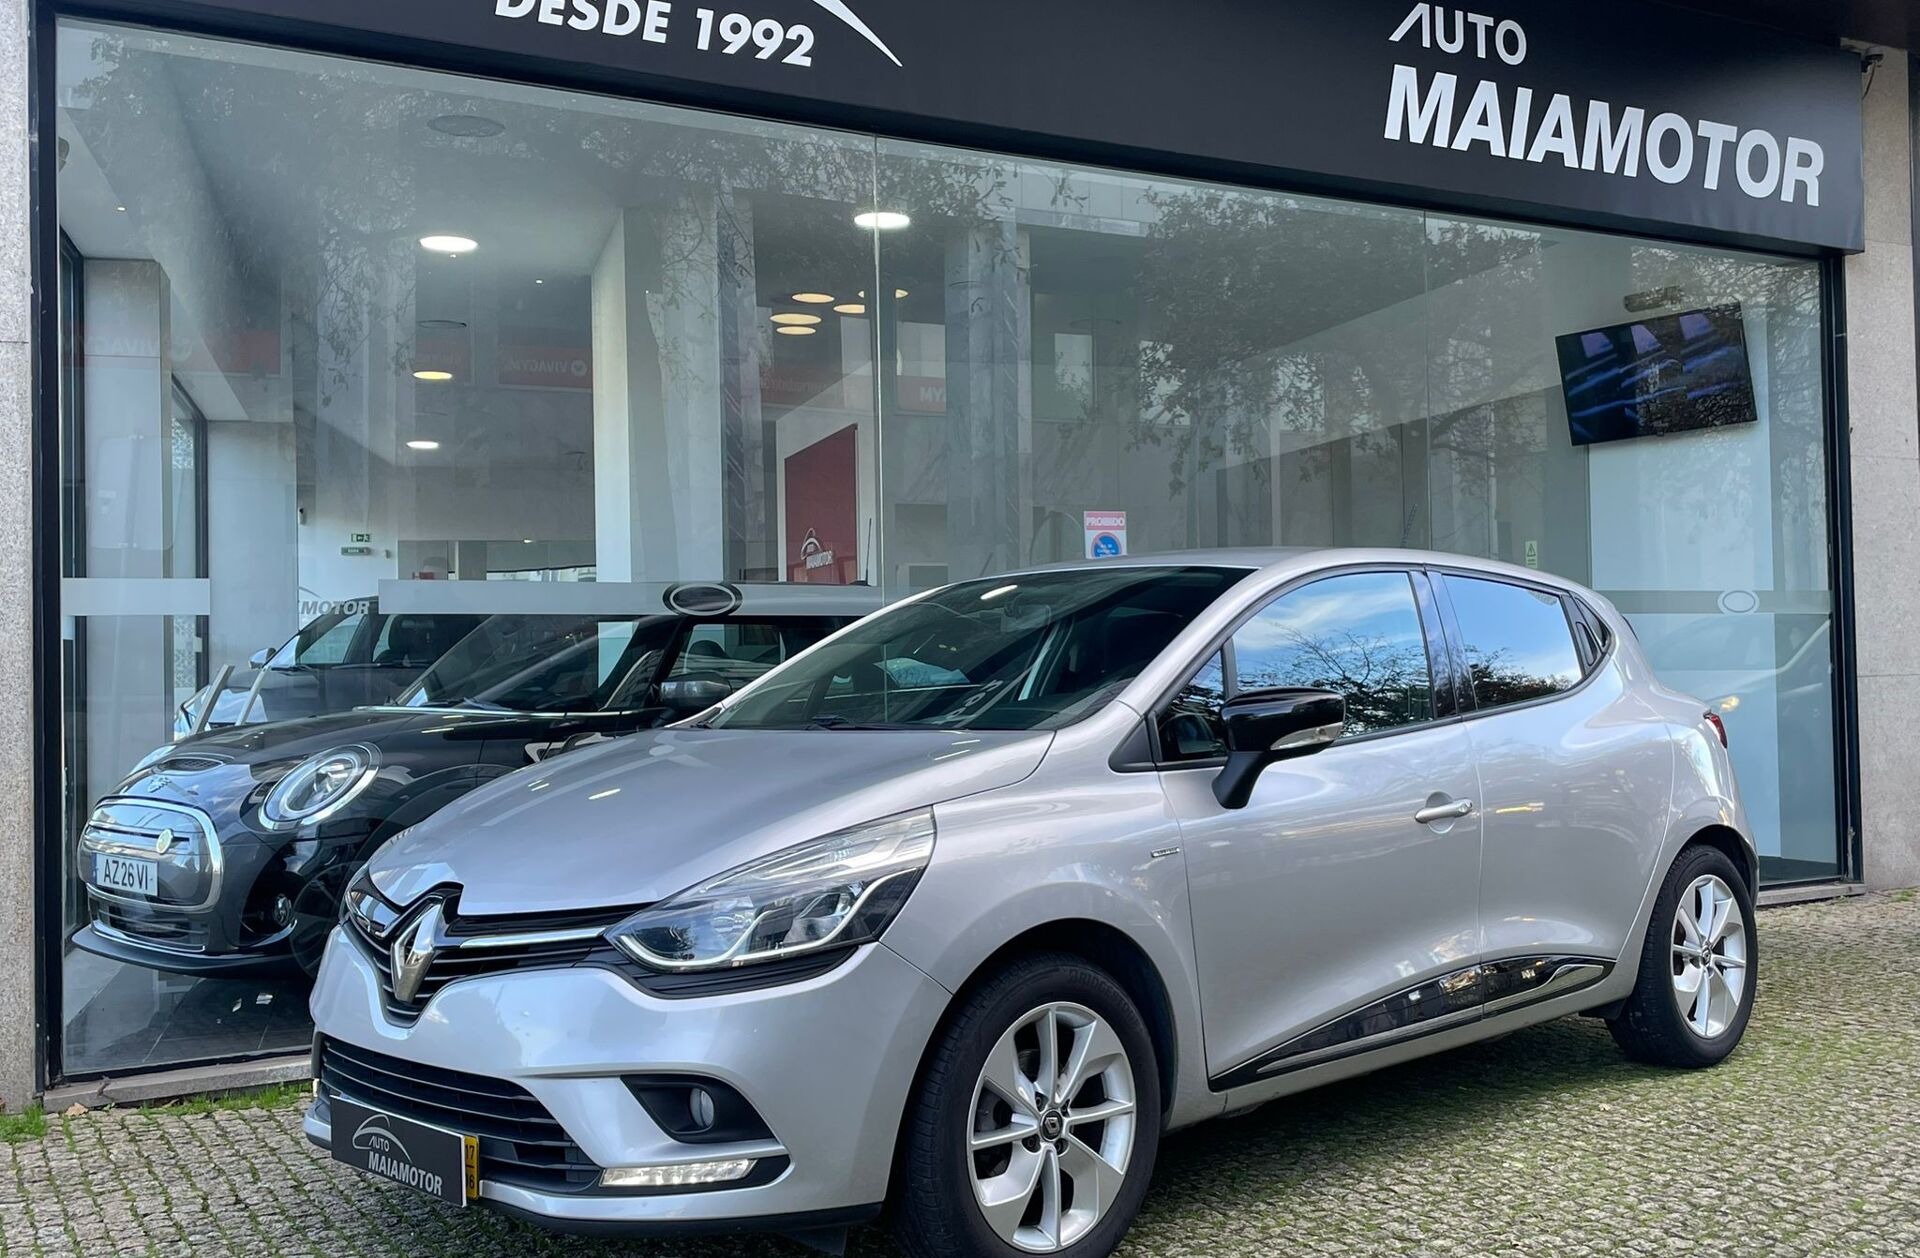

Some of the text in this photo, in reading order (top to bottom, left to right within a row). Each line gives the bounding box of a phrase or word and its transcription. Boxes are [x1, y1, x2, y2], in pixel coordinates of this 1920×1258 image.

[696, 8, 815, 68] 1992
[1389, 3, 1527, 66] AUTO
[1384, 64, 1825, 207] MAIAMOTOR
[367, 1151, 443, 1196] MAIAMOTOR
[368, 1136, 390, 1151] AUTO
